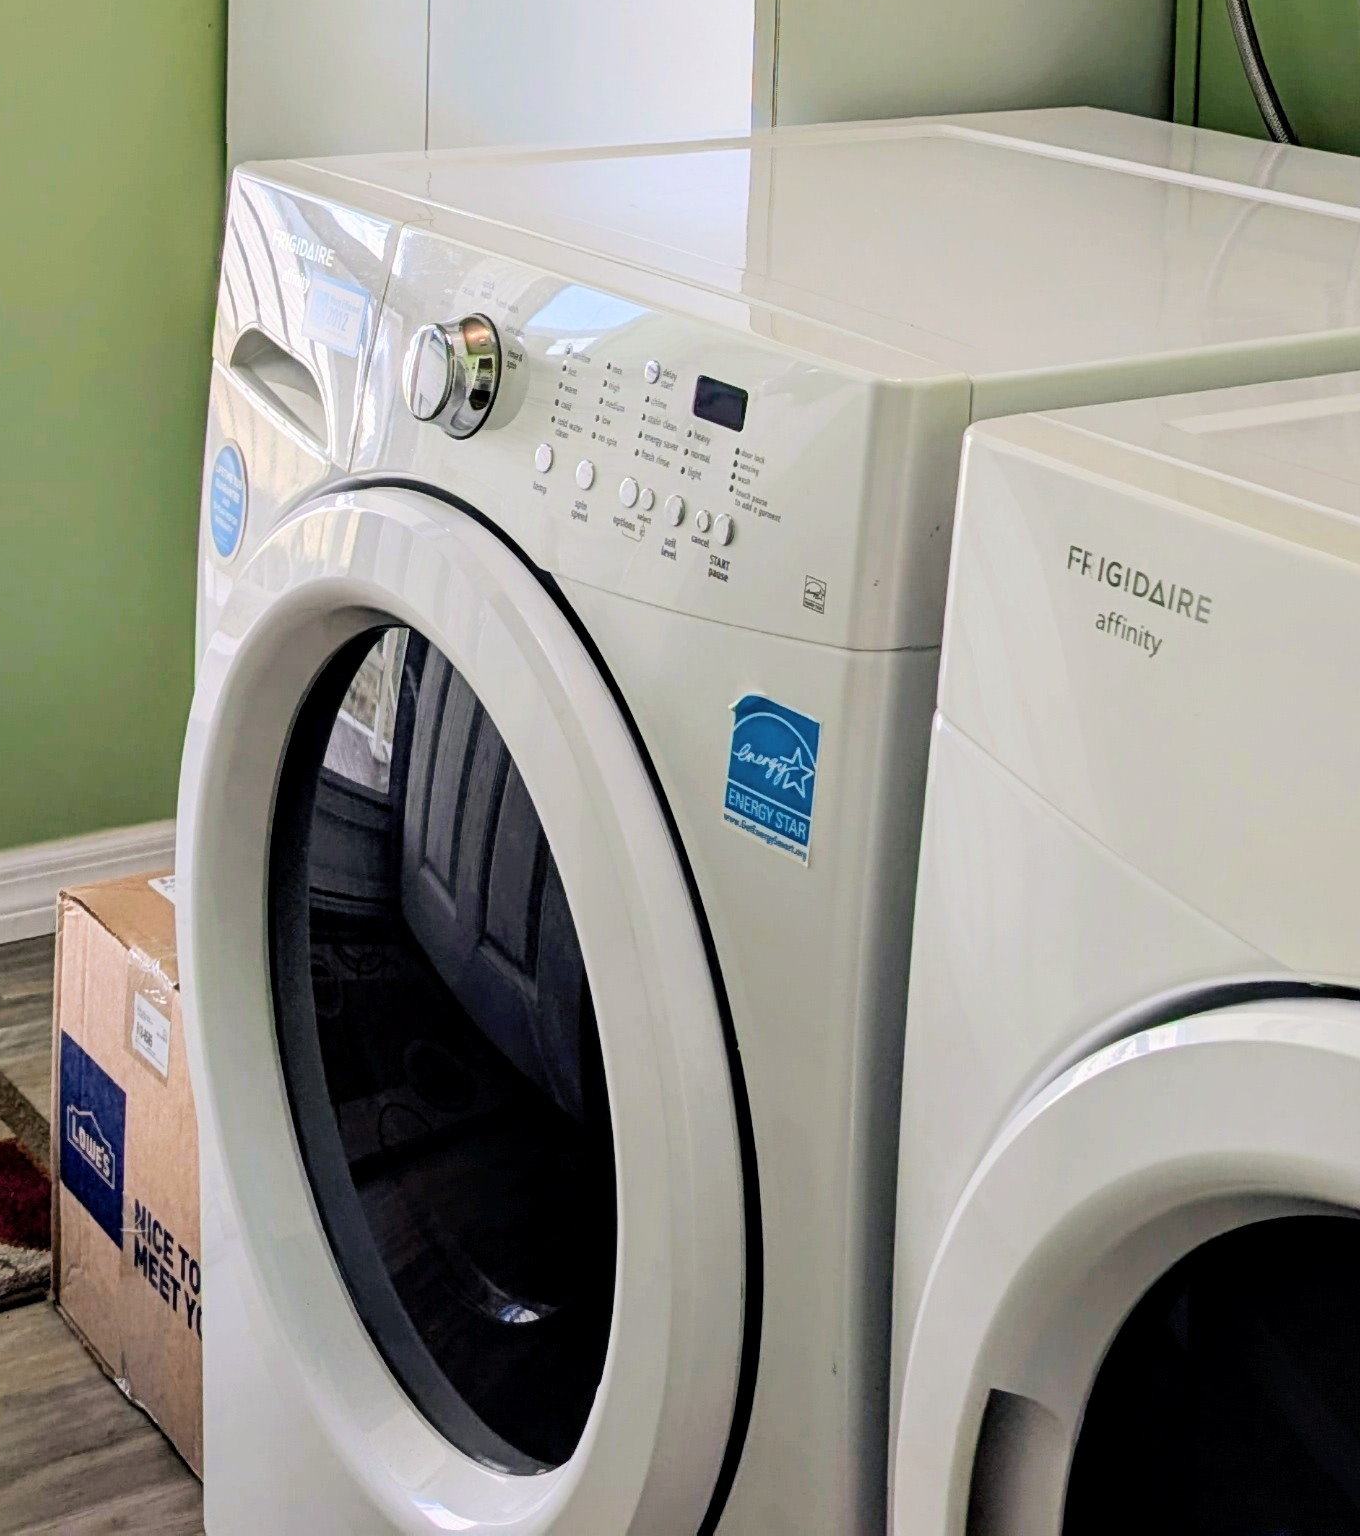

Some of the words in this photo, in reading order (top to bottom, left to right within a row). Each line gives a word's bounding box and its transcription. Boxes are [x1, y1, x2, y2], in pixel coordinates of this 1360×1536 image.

[272, 228, 336, 267] FRIGIDAIRE
[282, 266, 310, 294] affinity
[327, 306, 349, 332] 2012
[661, 545, 677, 561] level
[691, 534, 709, 548] cancel
[708, 567, 729, 583] pause
[709, 554, 730, 571] START
[1067, 545, 1212, 624] FRIGIDAIRE
[1095, 611, 1163, 658] affinity
[733, 743, 792, 786] energy
[728, 787, 773, 824] ENERGY
[775, 812, 808, 841] STAR
[71, 1114, 111, 1179] LOWE'S
[134, 1198, 174, 1269] NICE
[178, 1244, 202, 1296] TO
[134, 1233, 181, 1312] MEET
